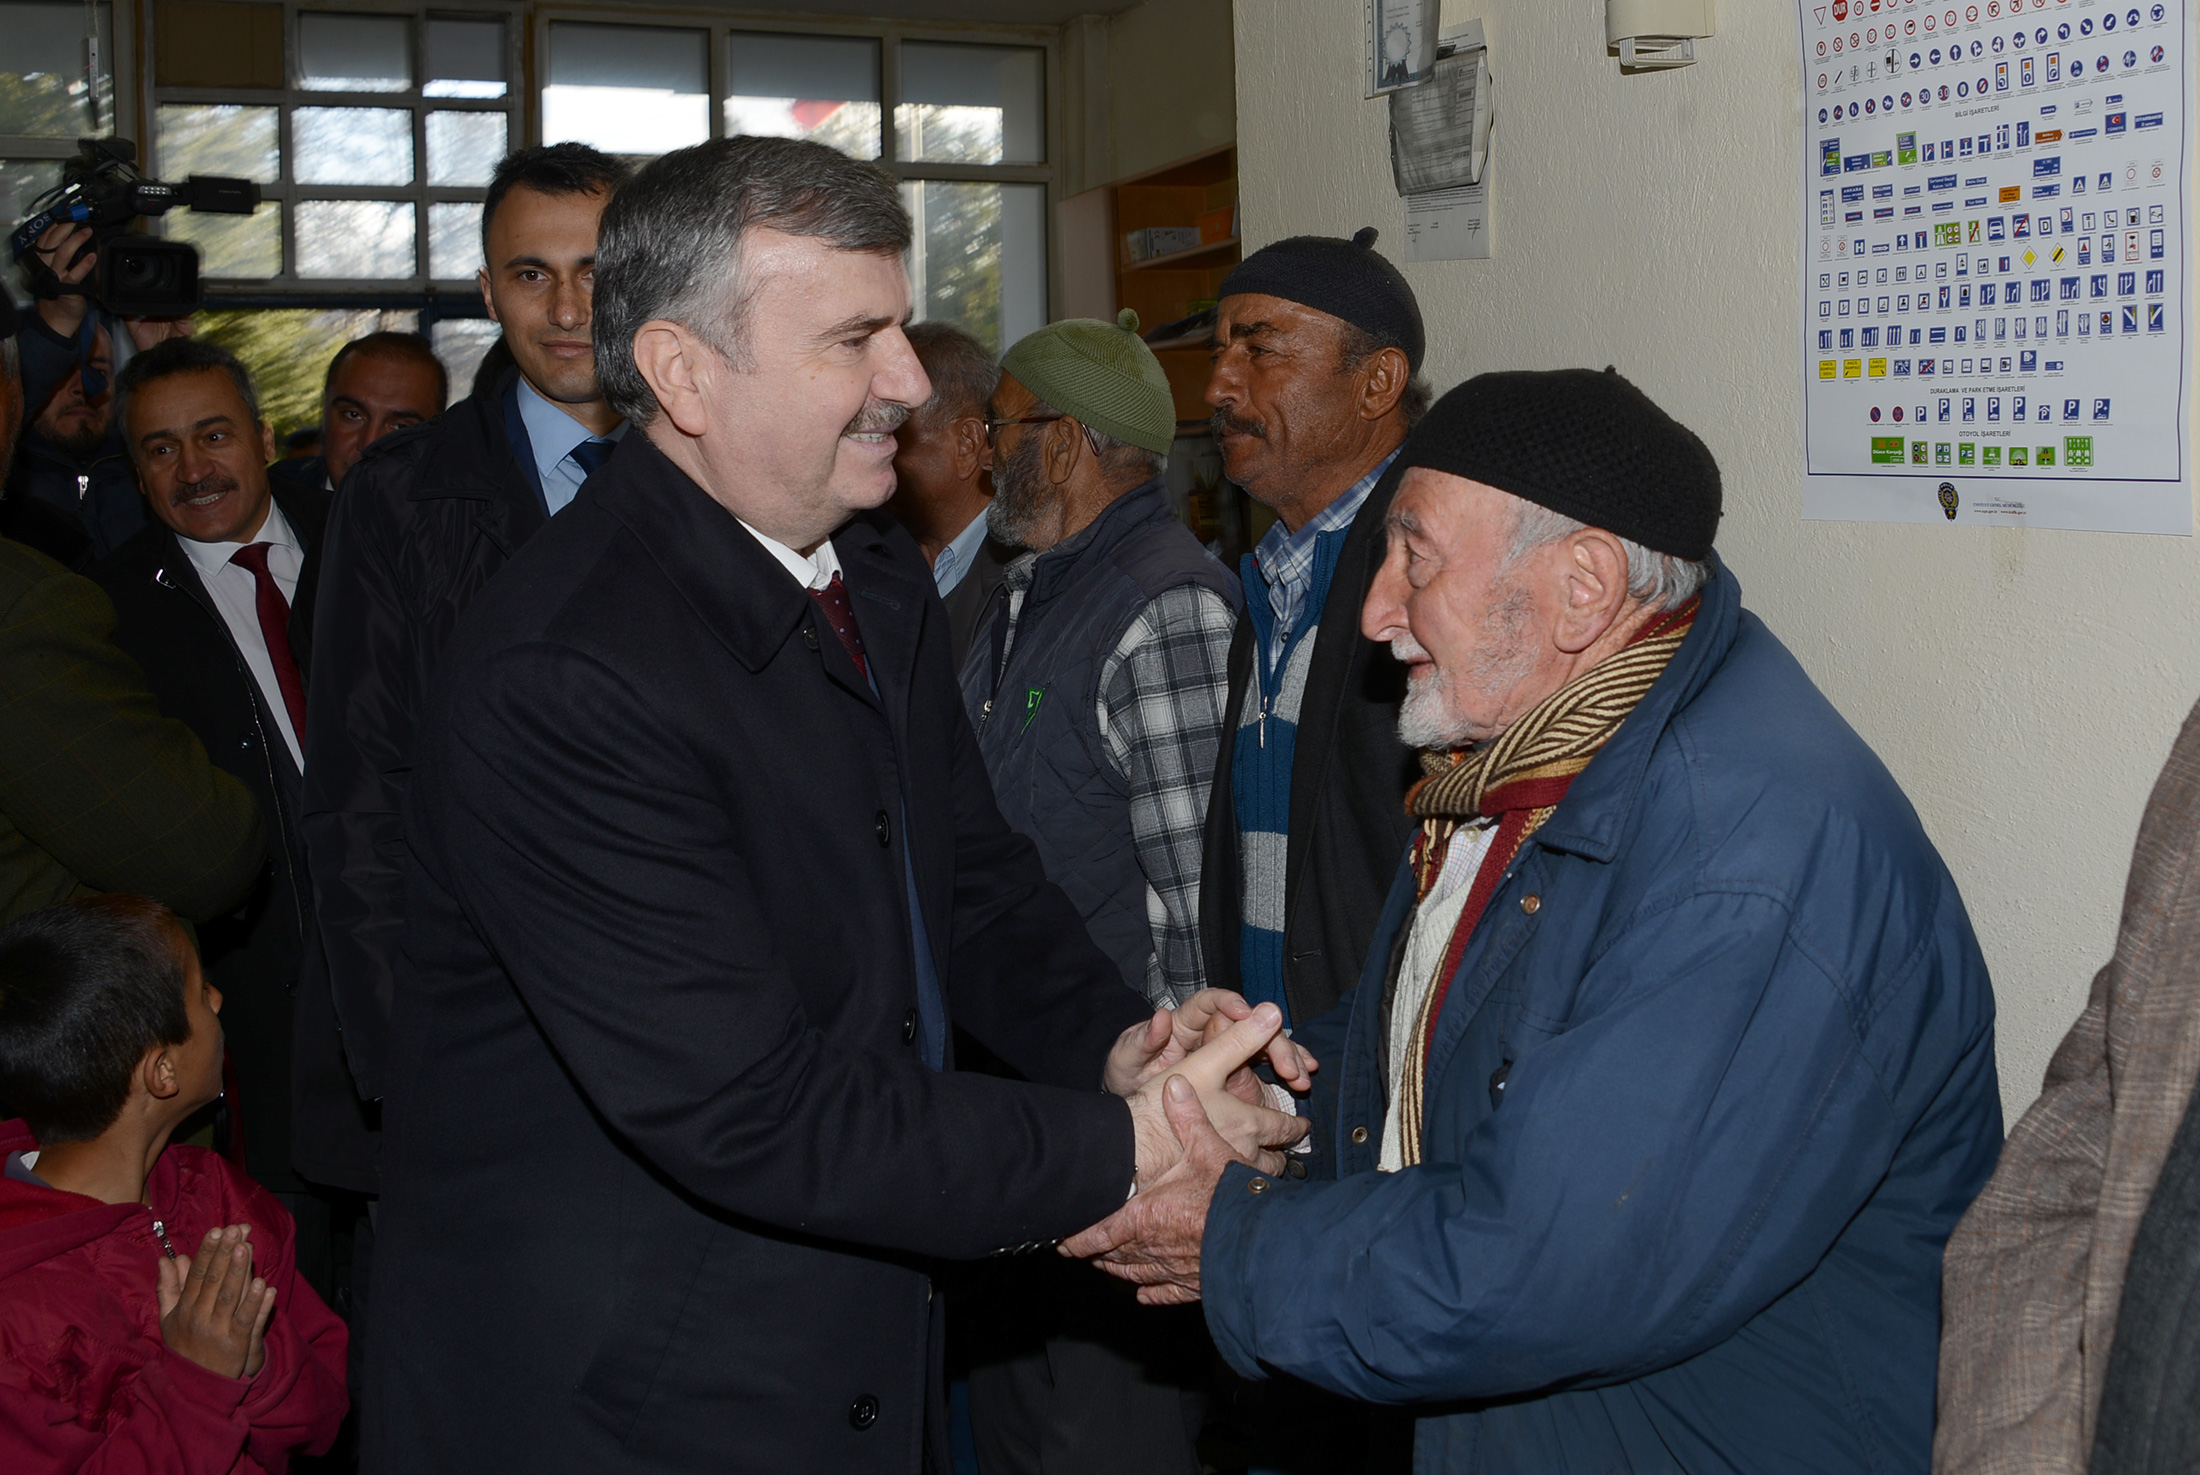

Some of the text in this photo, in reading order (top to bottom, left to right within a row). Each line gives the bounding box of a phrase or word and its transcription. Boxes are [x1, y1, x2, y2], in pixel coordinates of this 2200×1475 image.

[1833, 1, 1847, 15] DUR
[1920, 91, 1930, 101] 30
[1955, 104, 1999, 118] BİLGİ İŞARETLERİ
[2042, 221, 2049, 230] D
[1855, 242, 1864, 253] H
[1997, 384, 2026, 393] İŞARETLERİ
[1940, 399, 1948, 413] P
[1963, 399, 1972, 413] P
[1989, 398, 1998, 413] P
[2014, 398, 2023, 412] P
[2067, 401, 2076, 413] P
[2095, 400, 2104, 413] P
[1917, 408, 1925, 421] P
[2041, 410, 2048, 419] P
[1981, 429, 2011, 437] İŞARETLERİ
